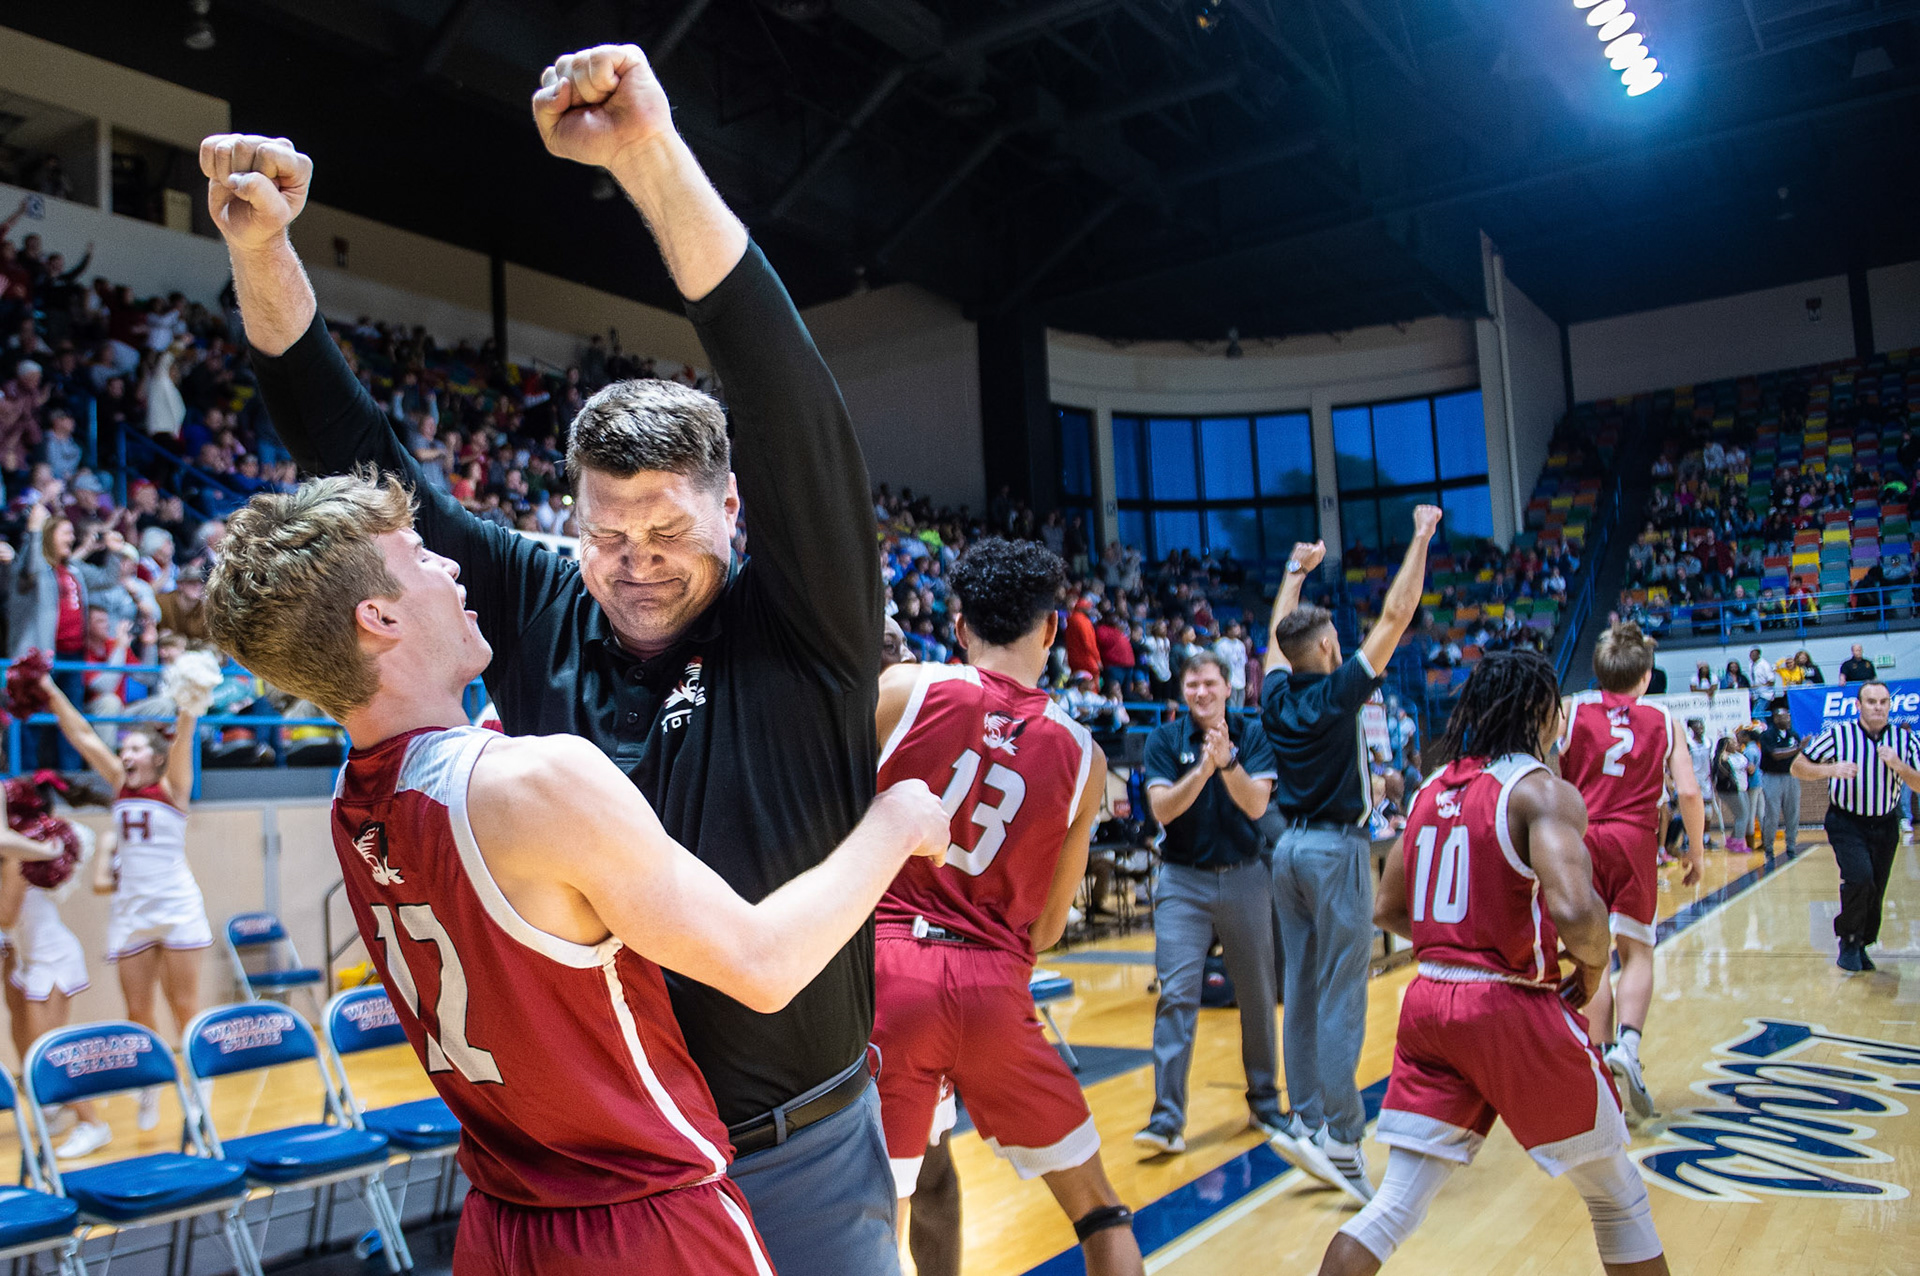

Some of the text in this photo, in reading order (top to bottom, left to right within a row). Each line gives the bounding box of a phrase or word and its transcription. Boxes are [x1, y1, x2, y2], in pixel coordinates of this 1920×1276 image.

[1822, 691, 1920, 718] Enre
[1602, 726, 1635, 778] 2
[122, 810, 152, 841] H
[941, 747, 1027, 876] 13
[1413, 825, 1470, 923] 10
[370, 903, 505, 1085] 12
[202, 1014, 295, 1044] WALLACE
[220, 1031, 282, 1053] STATE
[46, 1034, 152, 1067] WALLACE
[67, 1052, 138, 1077] STATE
